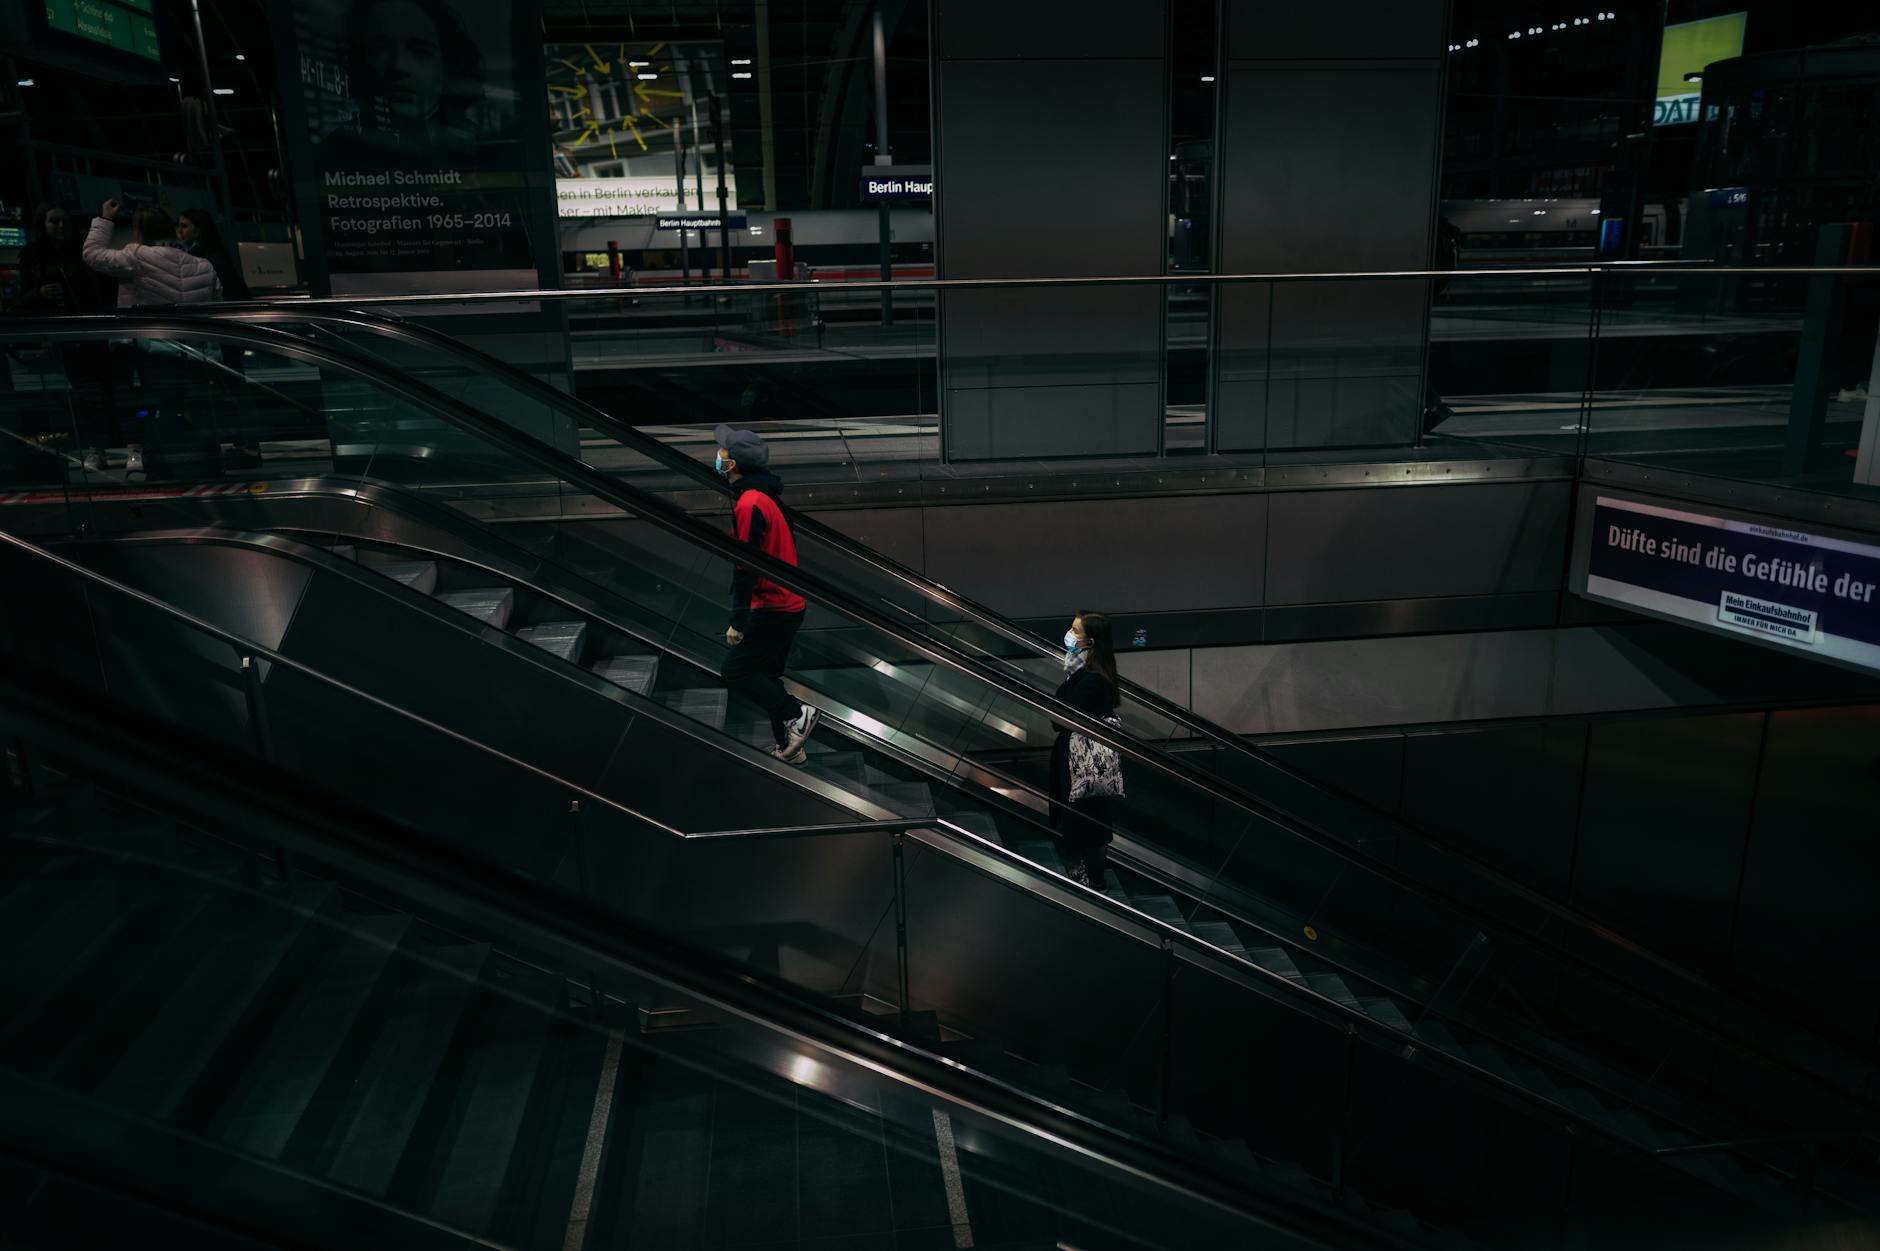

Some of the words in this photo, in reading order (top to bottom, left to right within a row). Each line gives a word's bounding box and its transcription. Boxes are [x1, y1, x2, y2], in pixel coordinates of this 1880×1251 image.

[325, 171, 390, 186] Michael
[394, 170, 463, 185] Schmidt
[580, 189, 591, 199] in
[595, 188, 632, 199] Berlin
[635, 186, 698, 198] verkauen
[868, 181, 902, 193] Berlin
[328, 193, 445, 211] Retrospektive.
[593, 205, 613, 217] mit
[617, 203, 660, 216] Makler
[330, 216, 422, 234] Fotografien
[659, 219, 680, 228] Berlin
[1749, 526, 1809, 543] einkaufsbahnhof.de
[1607, 525, 1656, 556] Düfte
[1660, 537, 1701, 565] sind
[1705, 546, 1736, 573] die
[1742, 553, 1828, 593] Gefühle
[1834, 572, 1876, 603] der
[1726, 595, 1744, 607] Mein
[1745, 599, 1811, 623] Einkaufsbahnhof
[1734, 615, 1755, 626] IMMER
[1756, 619, 1769, 629] FÜR
[1770, 623, 1786, 634] MICH
[1787, 628, 1797, 637] DA
